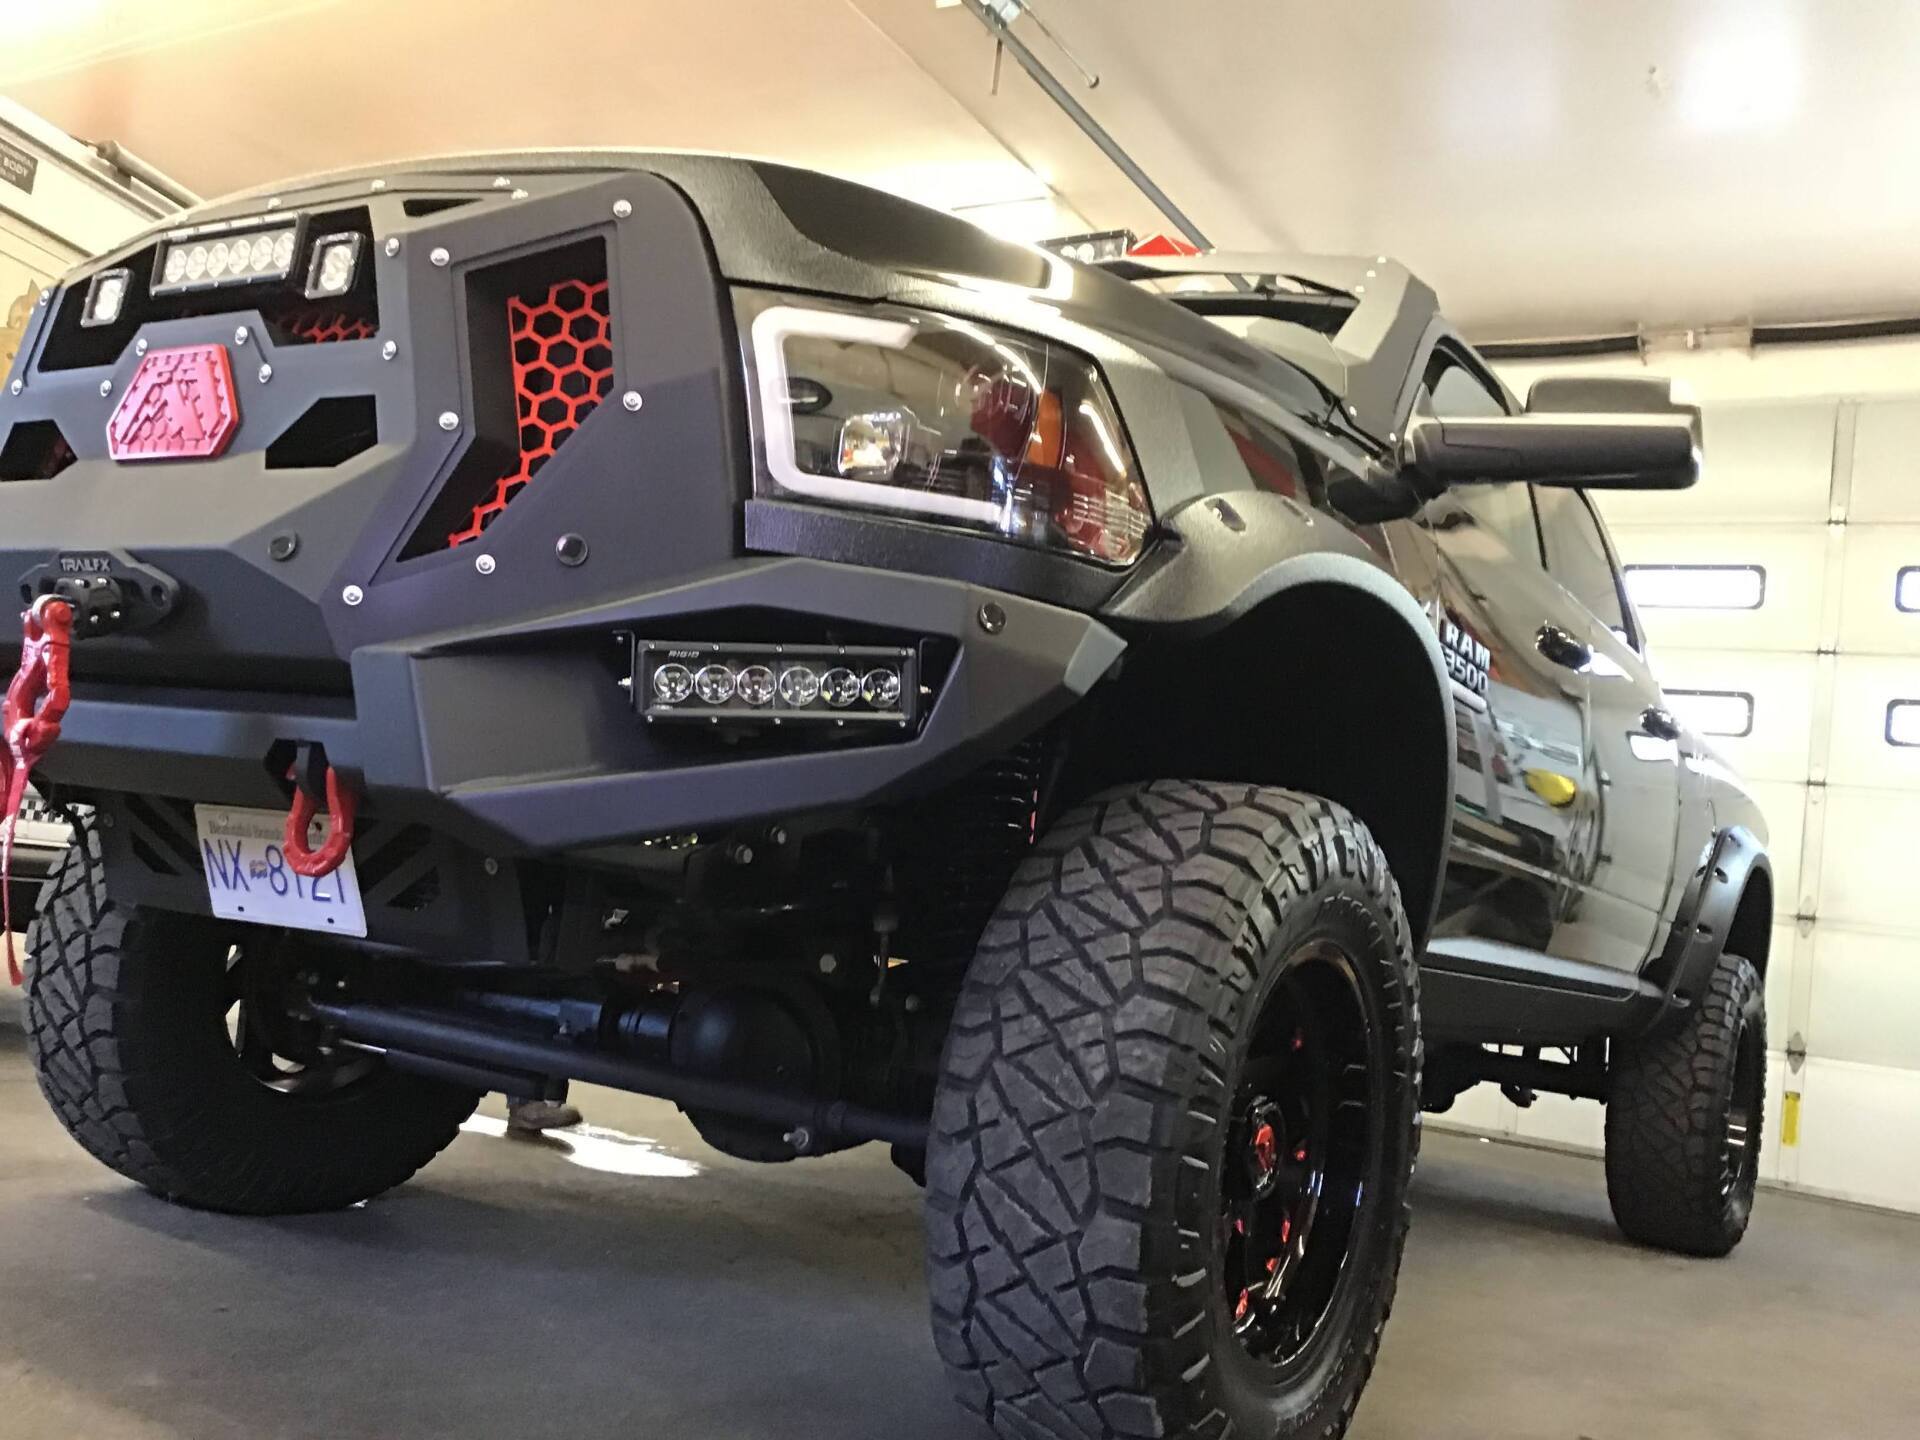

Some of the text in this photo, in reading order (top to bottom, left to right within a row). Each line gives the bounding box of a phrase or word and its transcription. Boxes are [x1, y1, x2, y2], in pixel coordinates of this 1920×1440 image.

[61, 558, 110, 572] TRAILFX
[668, 650, 700, 658] RIGID
[1440, 643, 1488, 695] 3500
[1445, 622, 1491, 671] RAM
[204, 838, 249, 891] NX
